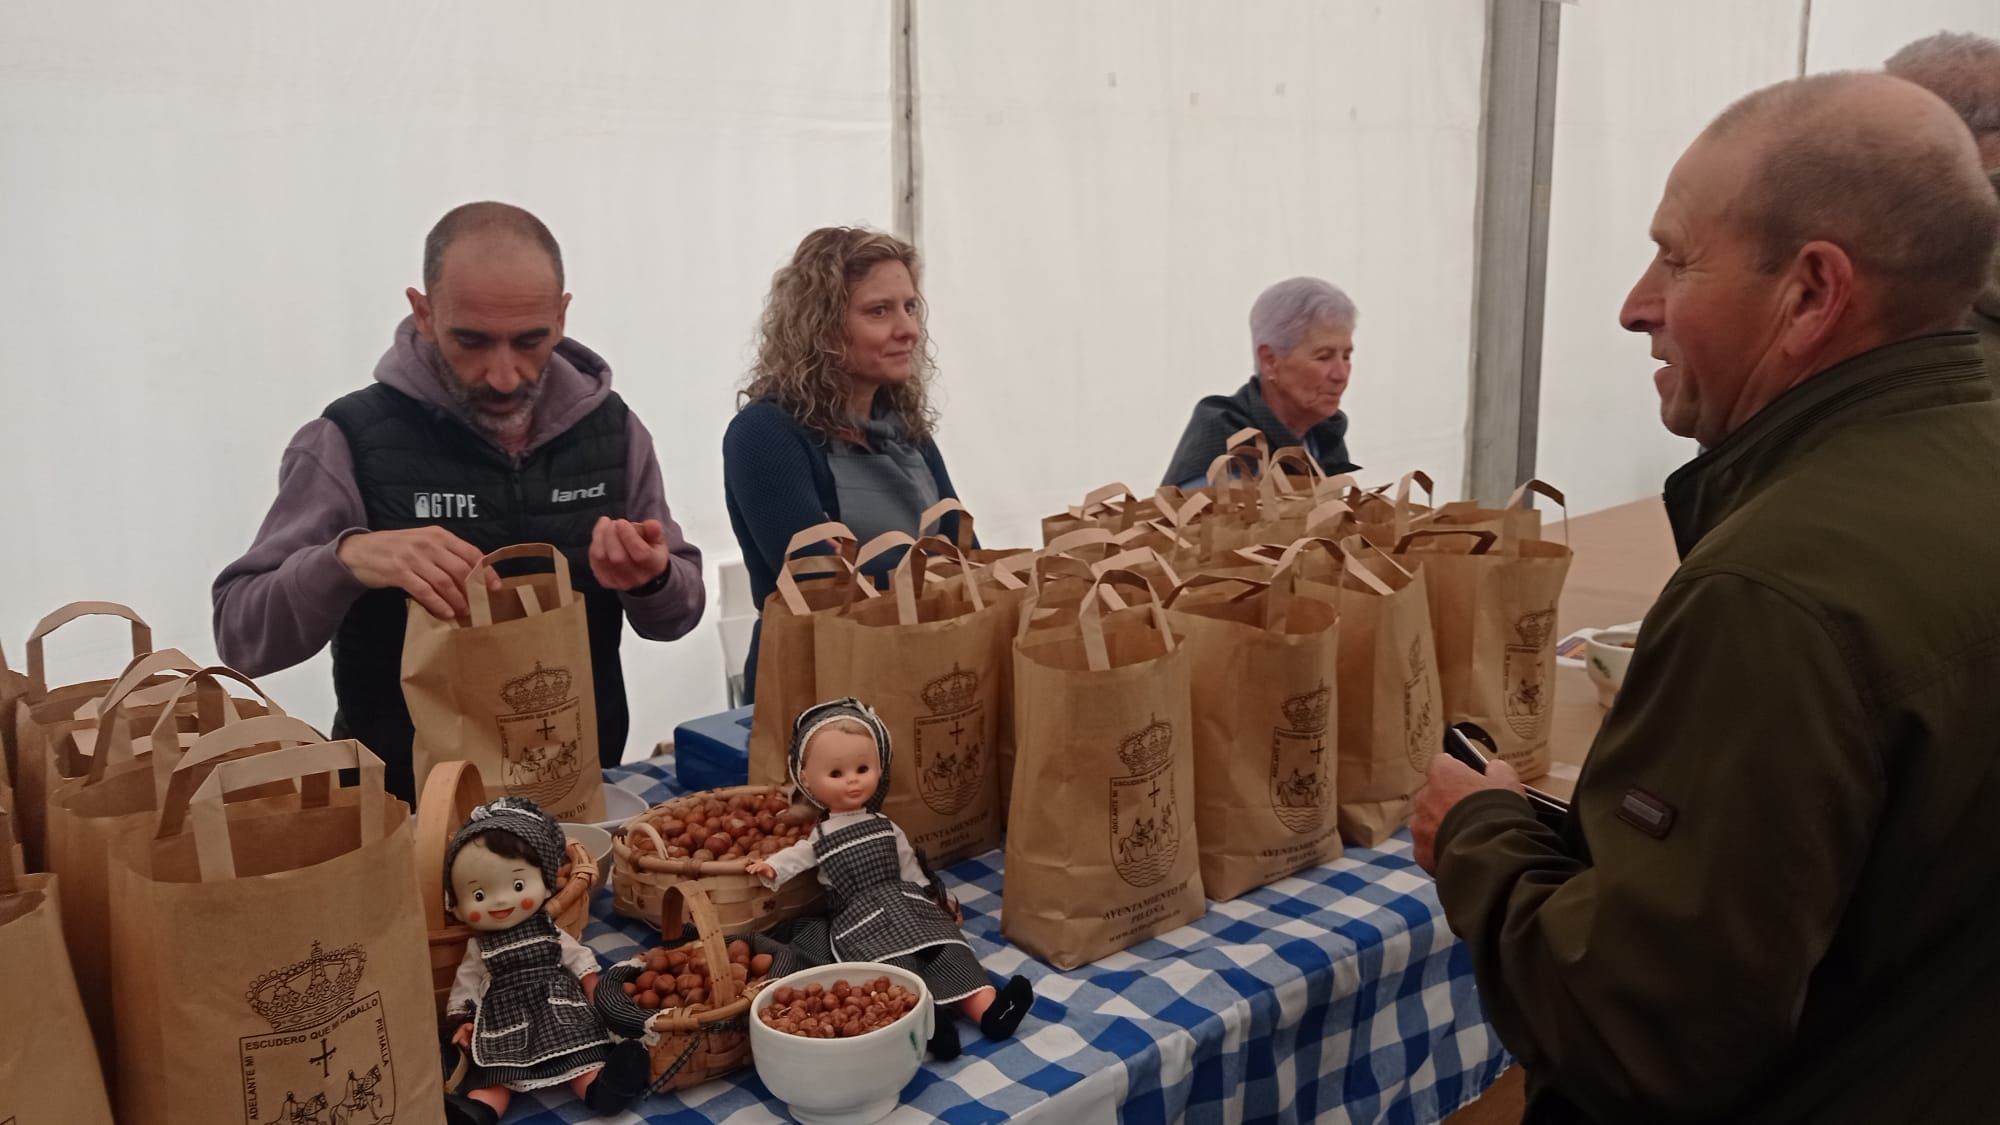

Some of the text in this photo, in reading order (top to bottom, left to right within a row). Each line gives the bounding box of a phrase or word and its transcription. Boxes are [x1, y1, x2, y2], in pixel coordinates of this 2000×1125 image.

[431, 492, 479, 518] GTPE
[245, 1035, 306, 1051] ESCUDERO
[310, 1025, 331, 1040] QUE
[340, 998, 379, 1024] CABALLO
[376, 1018, 390, 1067] PIE HALLA
[245, 1055, 259, 1120] ADELANTE MI
